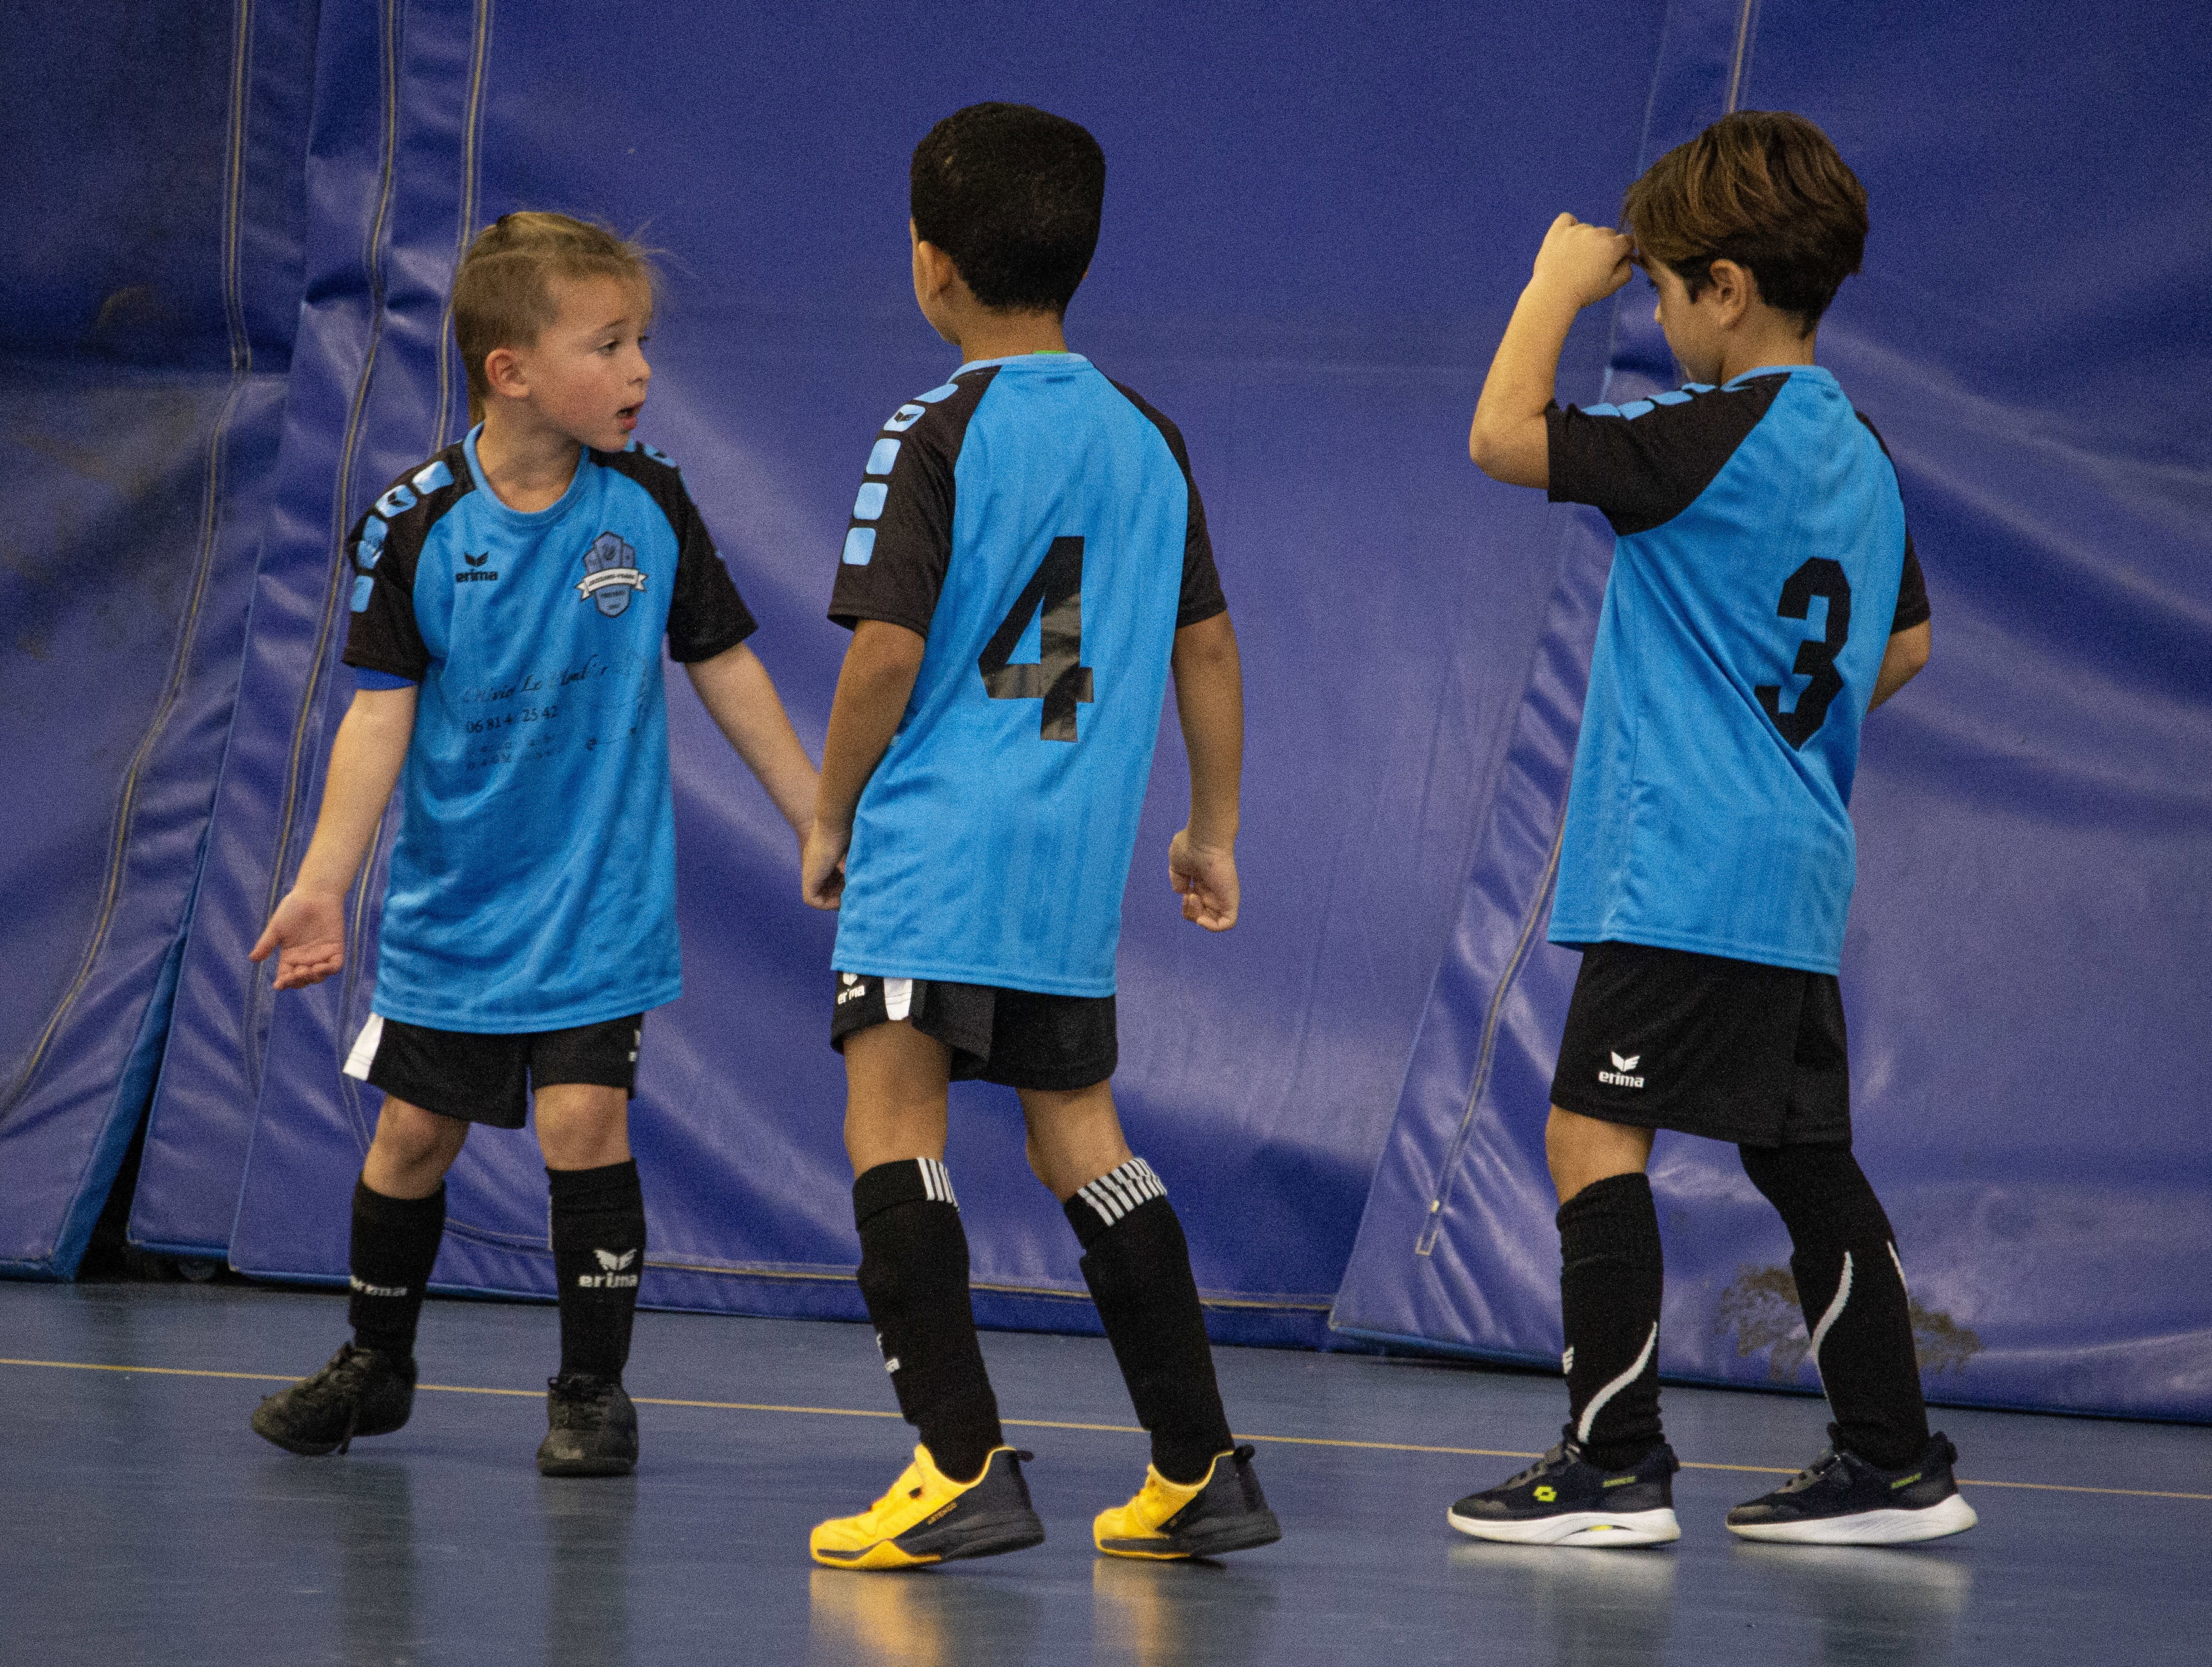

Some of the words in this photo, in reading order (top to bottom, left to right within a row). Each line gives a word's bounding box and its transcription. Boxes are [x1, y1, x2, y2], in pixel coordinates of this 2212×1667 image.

[455, 569, 499, 583] erima
[978, 536, 1094, 742] 4
[1754, 556, 1851, 752] 3
[465, 719, 483, 734] 06
[522, 708, 539, 722] 25
[837, 985, 865, 1005] erma
[1598, 1071, 1645, 1088] erima
[578, 1271, 638, 1288] erima
